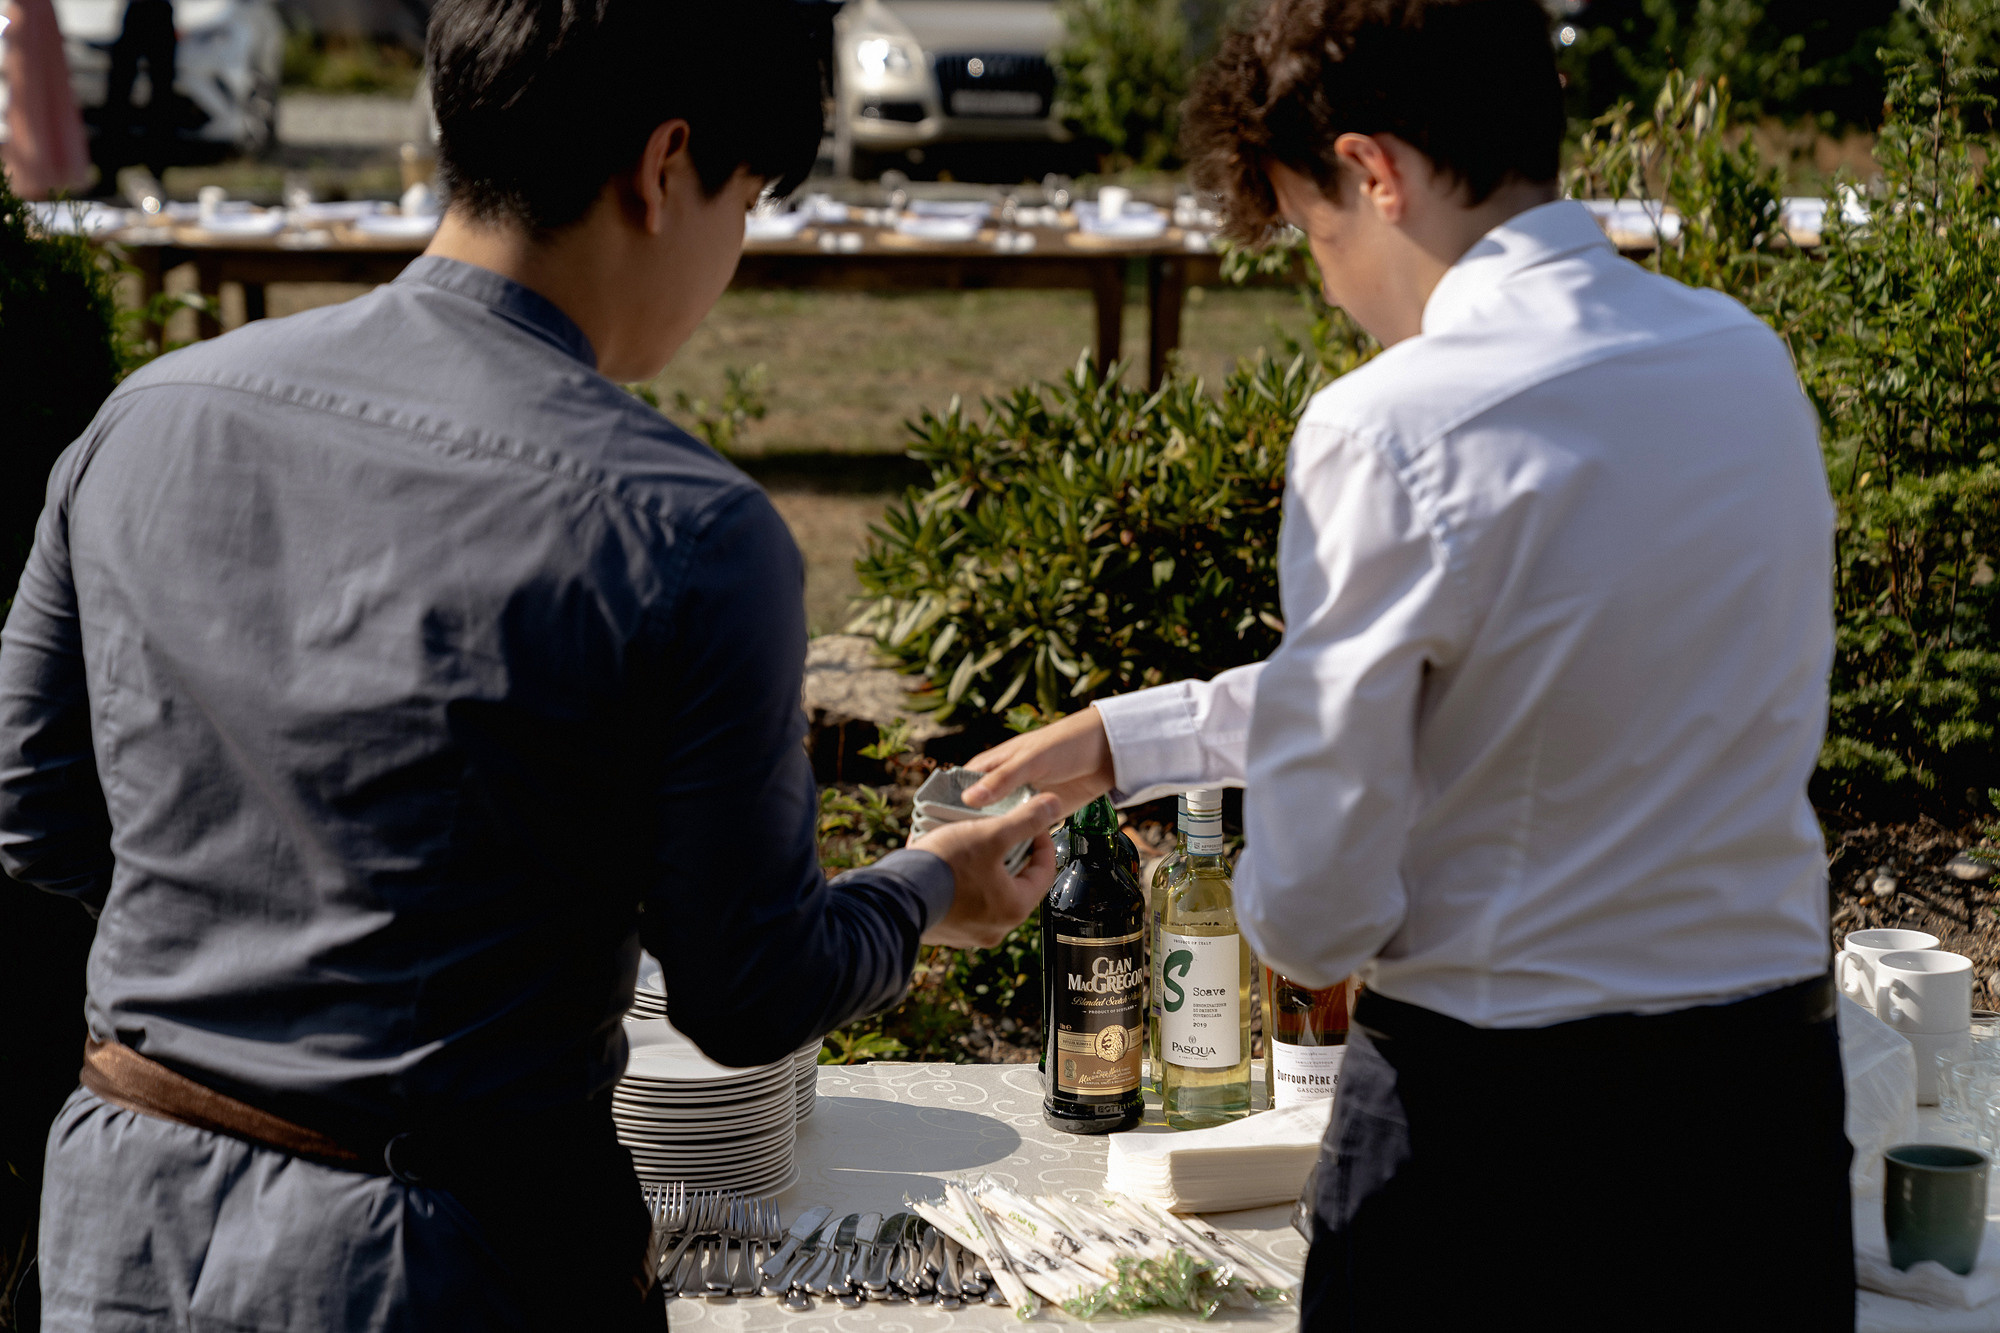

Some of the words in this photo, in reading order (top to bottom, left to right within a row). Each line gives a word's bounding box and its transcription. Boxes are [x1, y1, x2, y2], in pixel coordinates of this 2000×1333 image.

[1092, 956, 1132, 978] CLAN
[1193, 987, 1226, 997] Soave
[1071, 996, 1106, 1007] Blended
[1172, 1041, 1217, 1058] PASQUA
[1277, 1069, 1307, 1085] DUFFOUR
[1309, 1073, 1331, 1085] PÈRE
